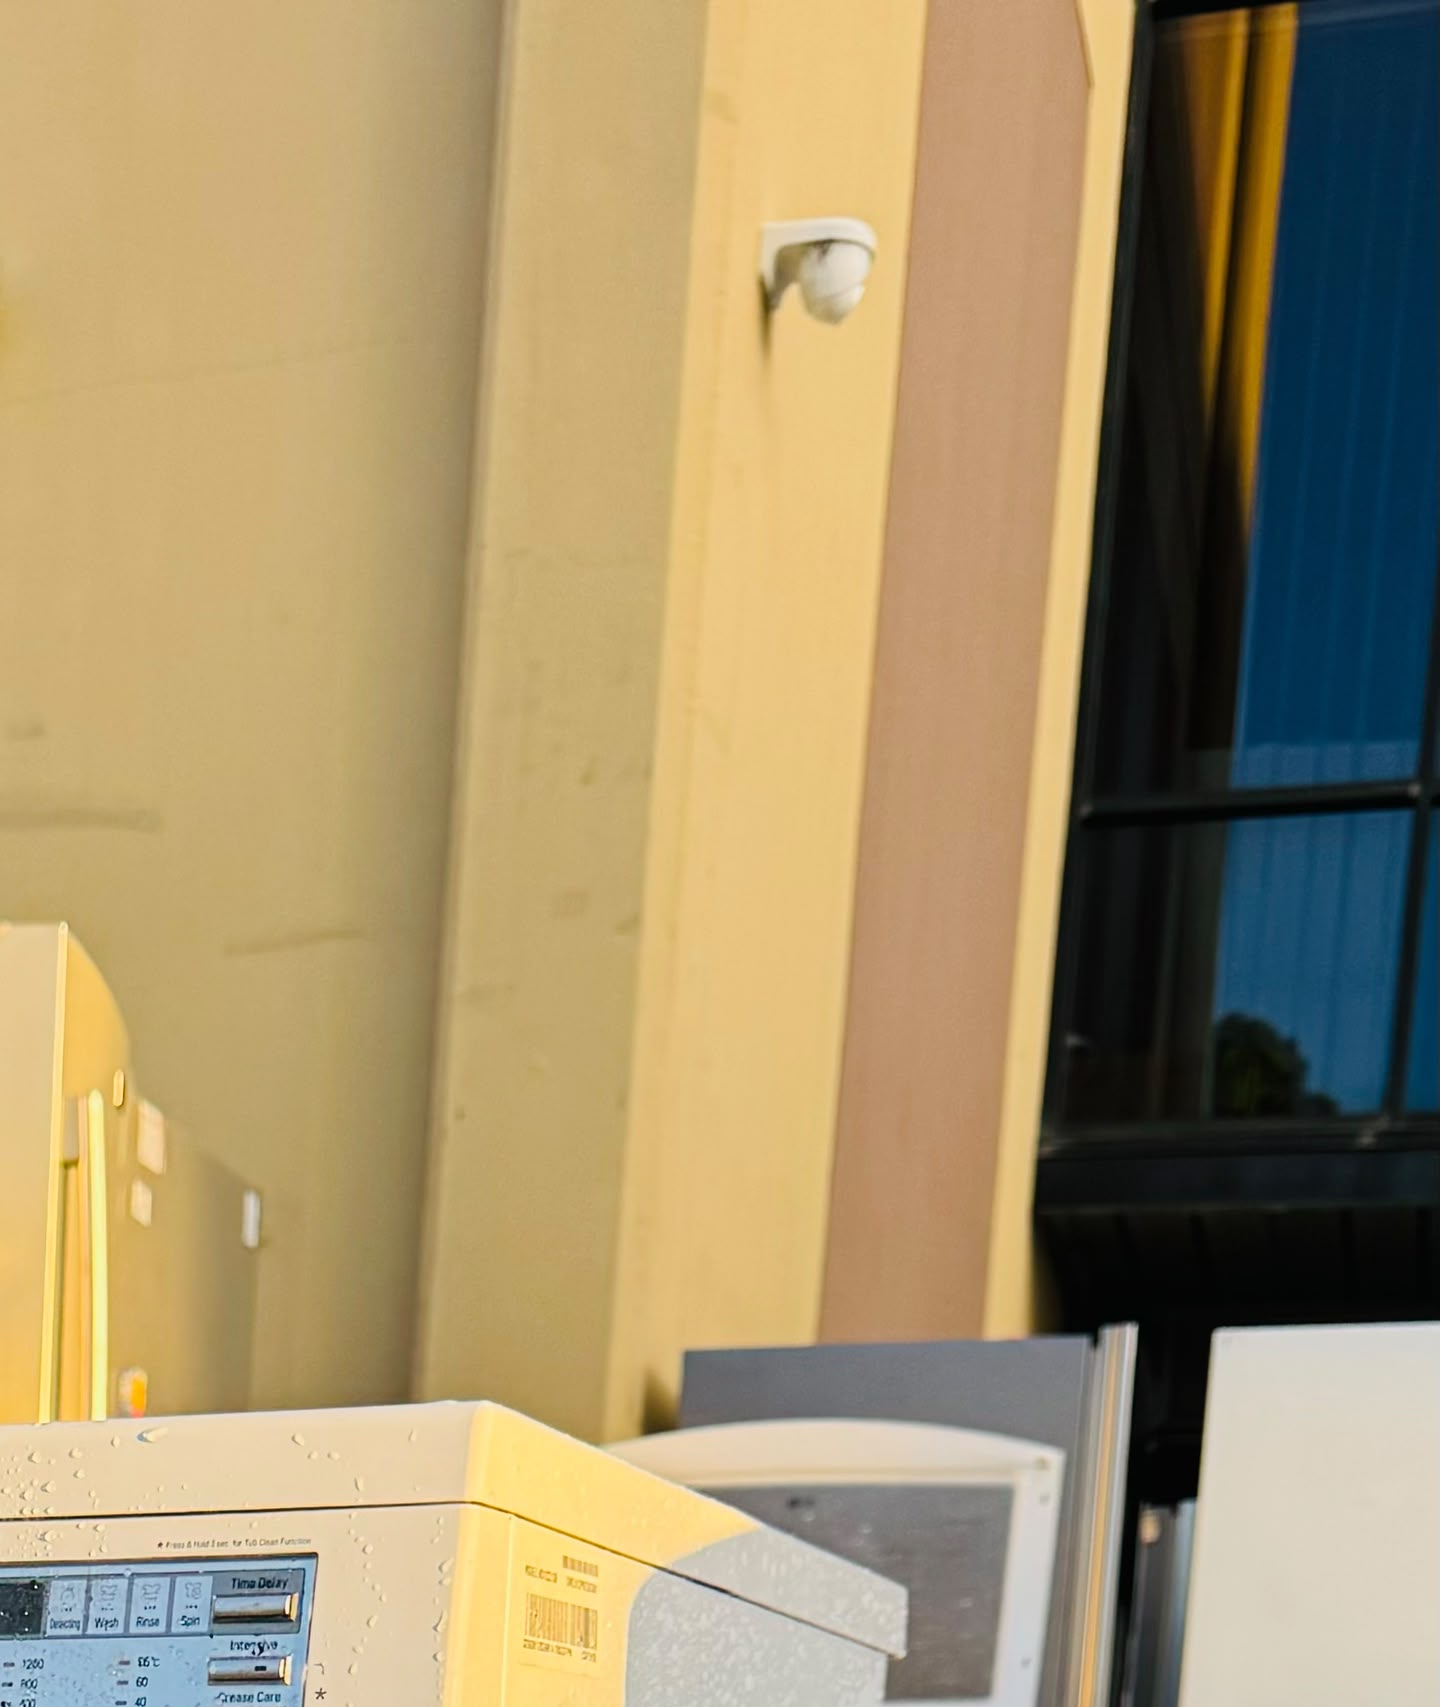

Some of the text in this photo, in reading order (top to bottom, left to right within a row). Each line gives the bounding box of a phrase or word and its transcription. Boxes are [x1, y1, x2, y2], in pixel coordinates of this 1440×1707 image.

[232, 1577, 288, 1590] Time Delay
[94, 1617, 119, 1631] Wash
[136, 1616, 160, 1627] Rinse
[180, 1615, 200, 1628] Spin
[136, 1677, 148, 1688] 60
[134, 1697, 147, 1707] 40
[257, 1691, 281, 1703] Care
